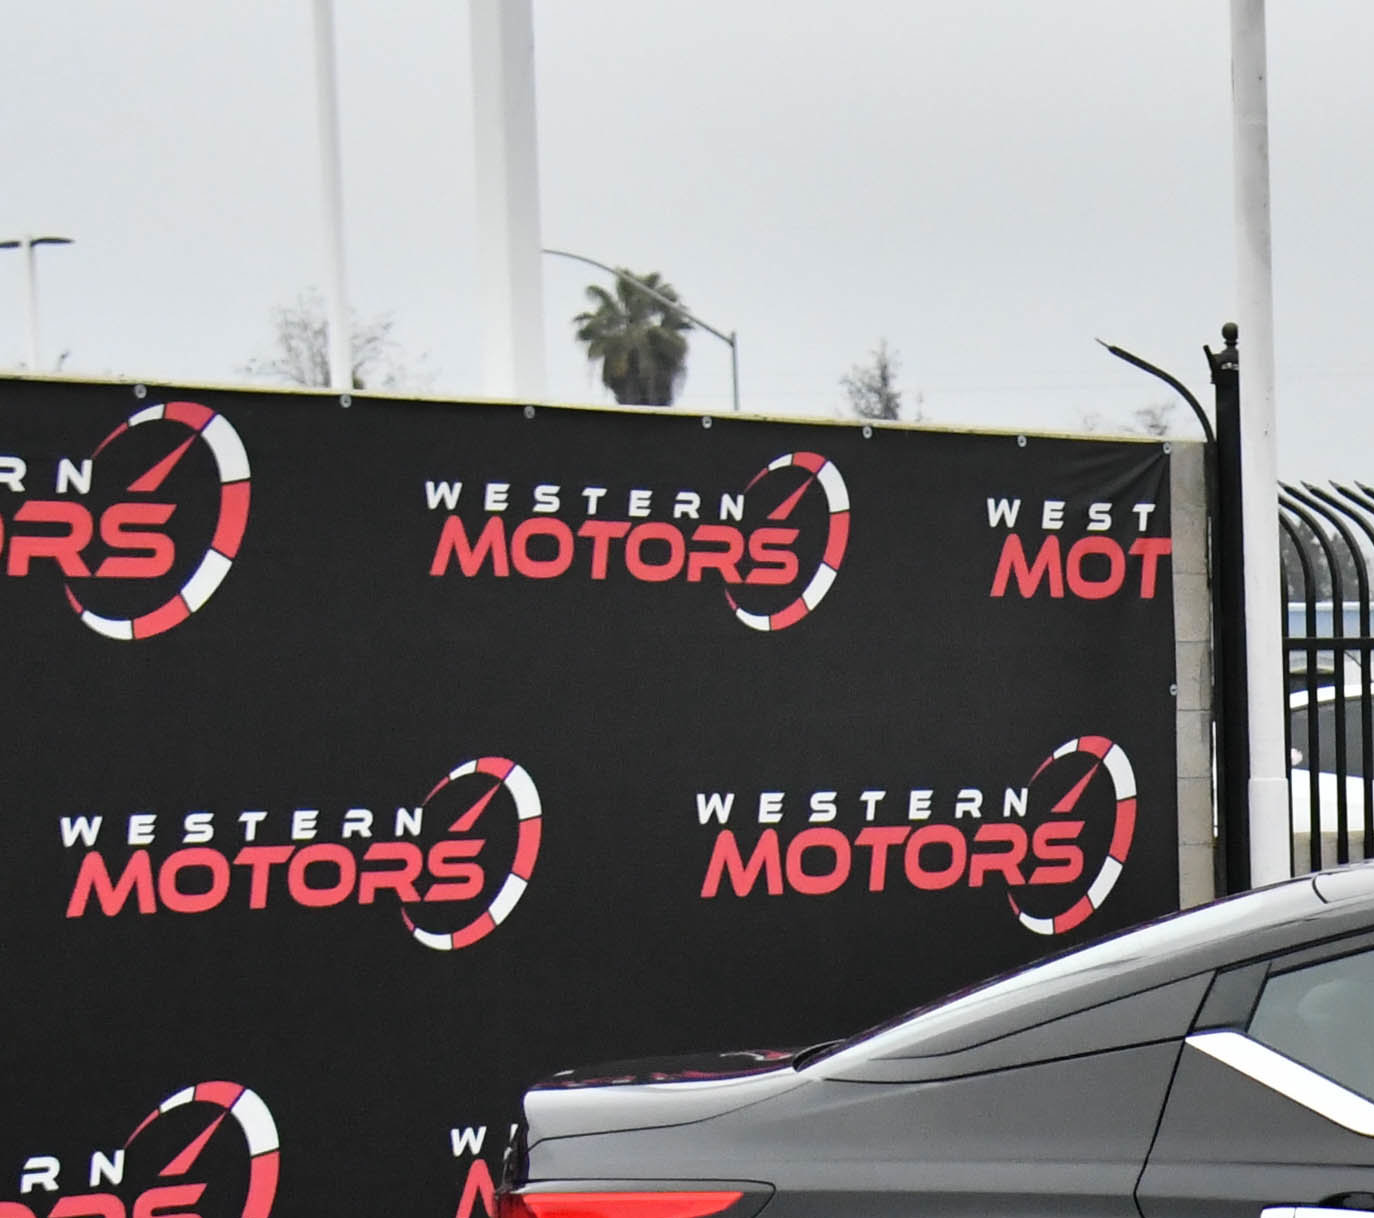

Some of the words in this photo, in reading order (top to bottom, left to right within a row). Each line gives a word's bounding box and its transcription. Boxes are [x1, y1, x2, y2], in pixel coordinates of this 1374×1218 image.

[425, 480, 746, 521] WESTERN
[986, 497, 1157, 532] WEST
[0, 500, 178, 579] RS
[430, 514, 801, 585] MOTORS
[990, 533, 1173, 600] MOT
[60, 807, 424, 848] WESTERN
[696, 787, 1030, 825] WESTERN
[66, 838, 487, 918] MOTORS
[700, 820, 1086, 898] MOTORS
